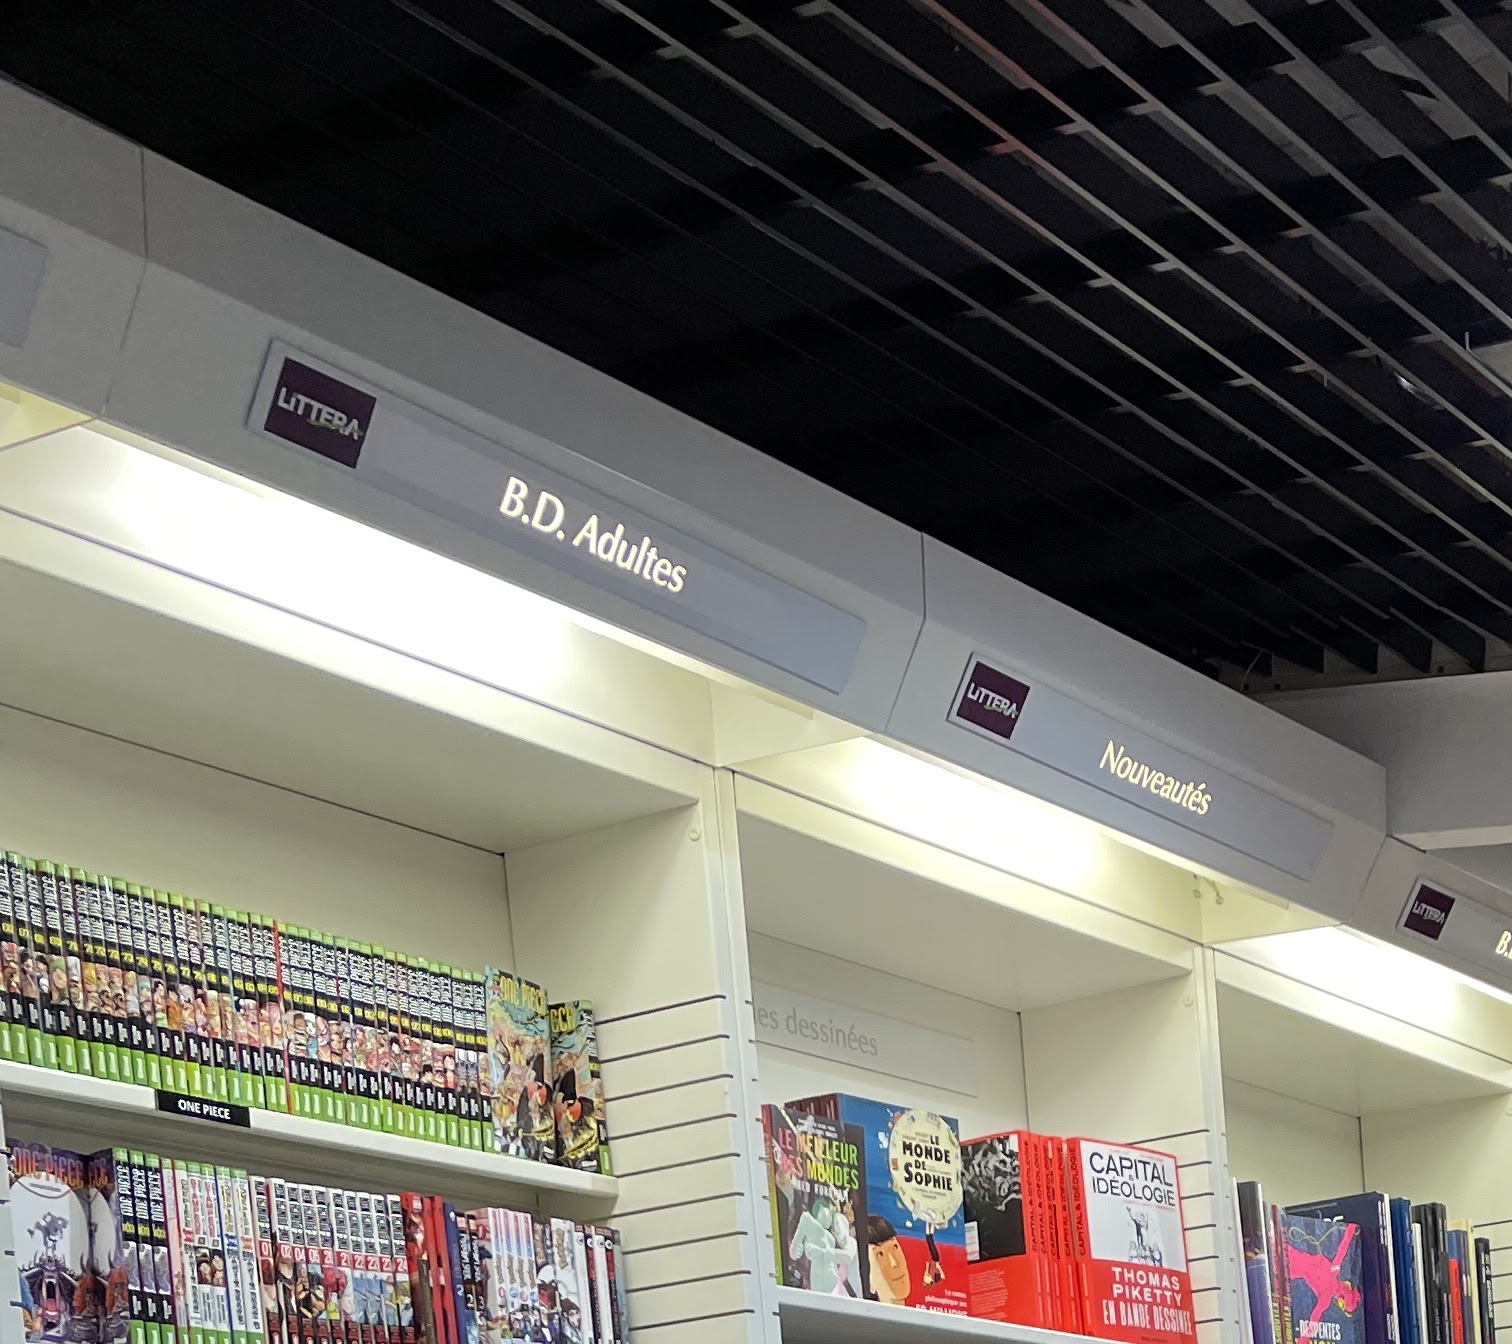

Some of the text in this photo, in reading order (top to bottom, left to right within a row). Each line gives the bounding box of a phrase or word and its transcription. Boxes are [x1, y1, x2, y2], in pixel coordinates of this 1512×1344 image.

[277, 386, 364, 441] LITTERA
[500, 476, 687, 592] B.D. Adultes
[967, 682, 1019, 720] LITTERA
[1100, 740, 1212, 816] Nouveautés
[178, 1099, 231, 1121] ONE PIECE
[902, 1141, 951, 1166] MONDE
[930, 1134, 940, 1146] LE
[903, 1161, 953, 1191] SOPHIE
[914, 1158, 927, 1172] DE
[1090, 1150, 1174, 1187] CAPITAL
[1092, 1175, 1176, 1207] IDÉOLOGIE
[1111, 1266, 1181, 1290] THOMAS
[1112, 1283, 1183, 1307] PIKETTY
[1102, 1299, 1116, 1326] EN
[1118, 1302, 1151, 1329] BANDE
